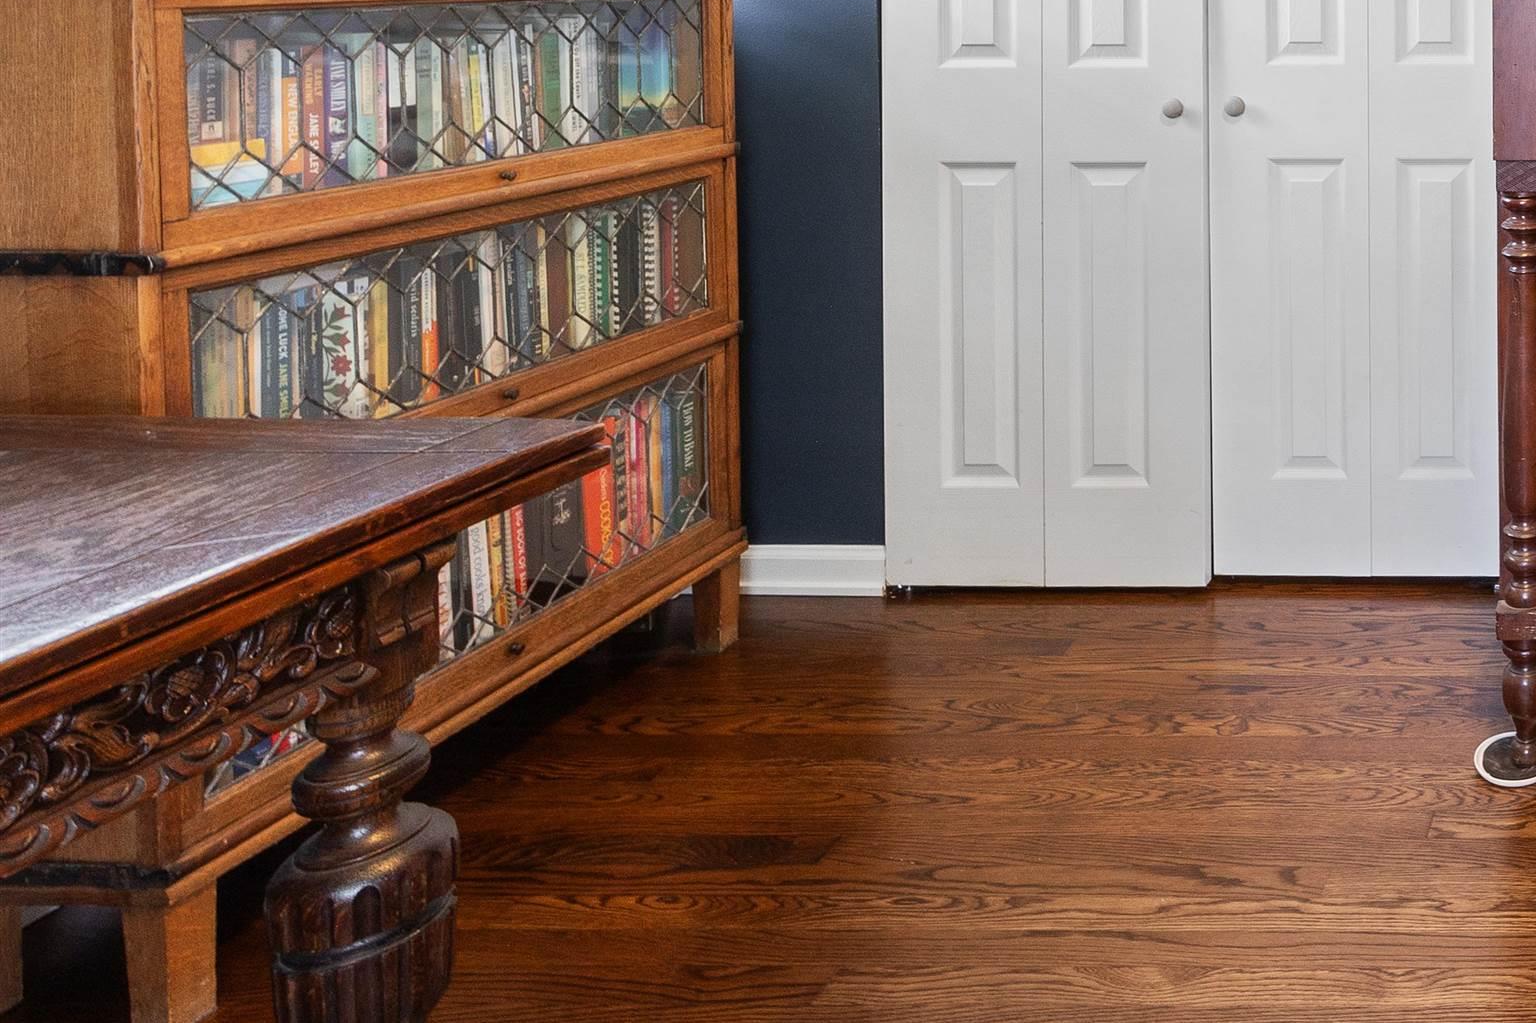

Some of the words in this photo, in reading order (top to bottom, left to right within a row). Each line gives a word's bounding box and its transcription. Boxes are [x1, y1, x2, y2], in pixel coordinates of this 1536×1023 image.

[288, 84, 297, 107] NEW
[305, 64, 313, 105] WARNING
[314, 69, 322, 97] EARLY
[206, 96, 216, 121] BUCK
[288, 112, 299, 161] ENGLAD
[309, 113, 319, 138] JANE
[310, 139, 319, 174] SILEY
[279, 333, 288, 360] LUCK
[279, 363, 288, 389] JANE
[469, 527, 486, 554] good
[516, 529, 525, 556] BOOK
[474, 557, 487, 590] cooks
[477, 591, 488, 616] kno
